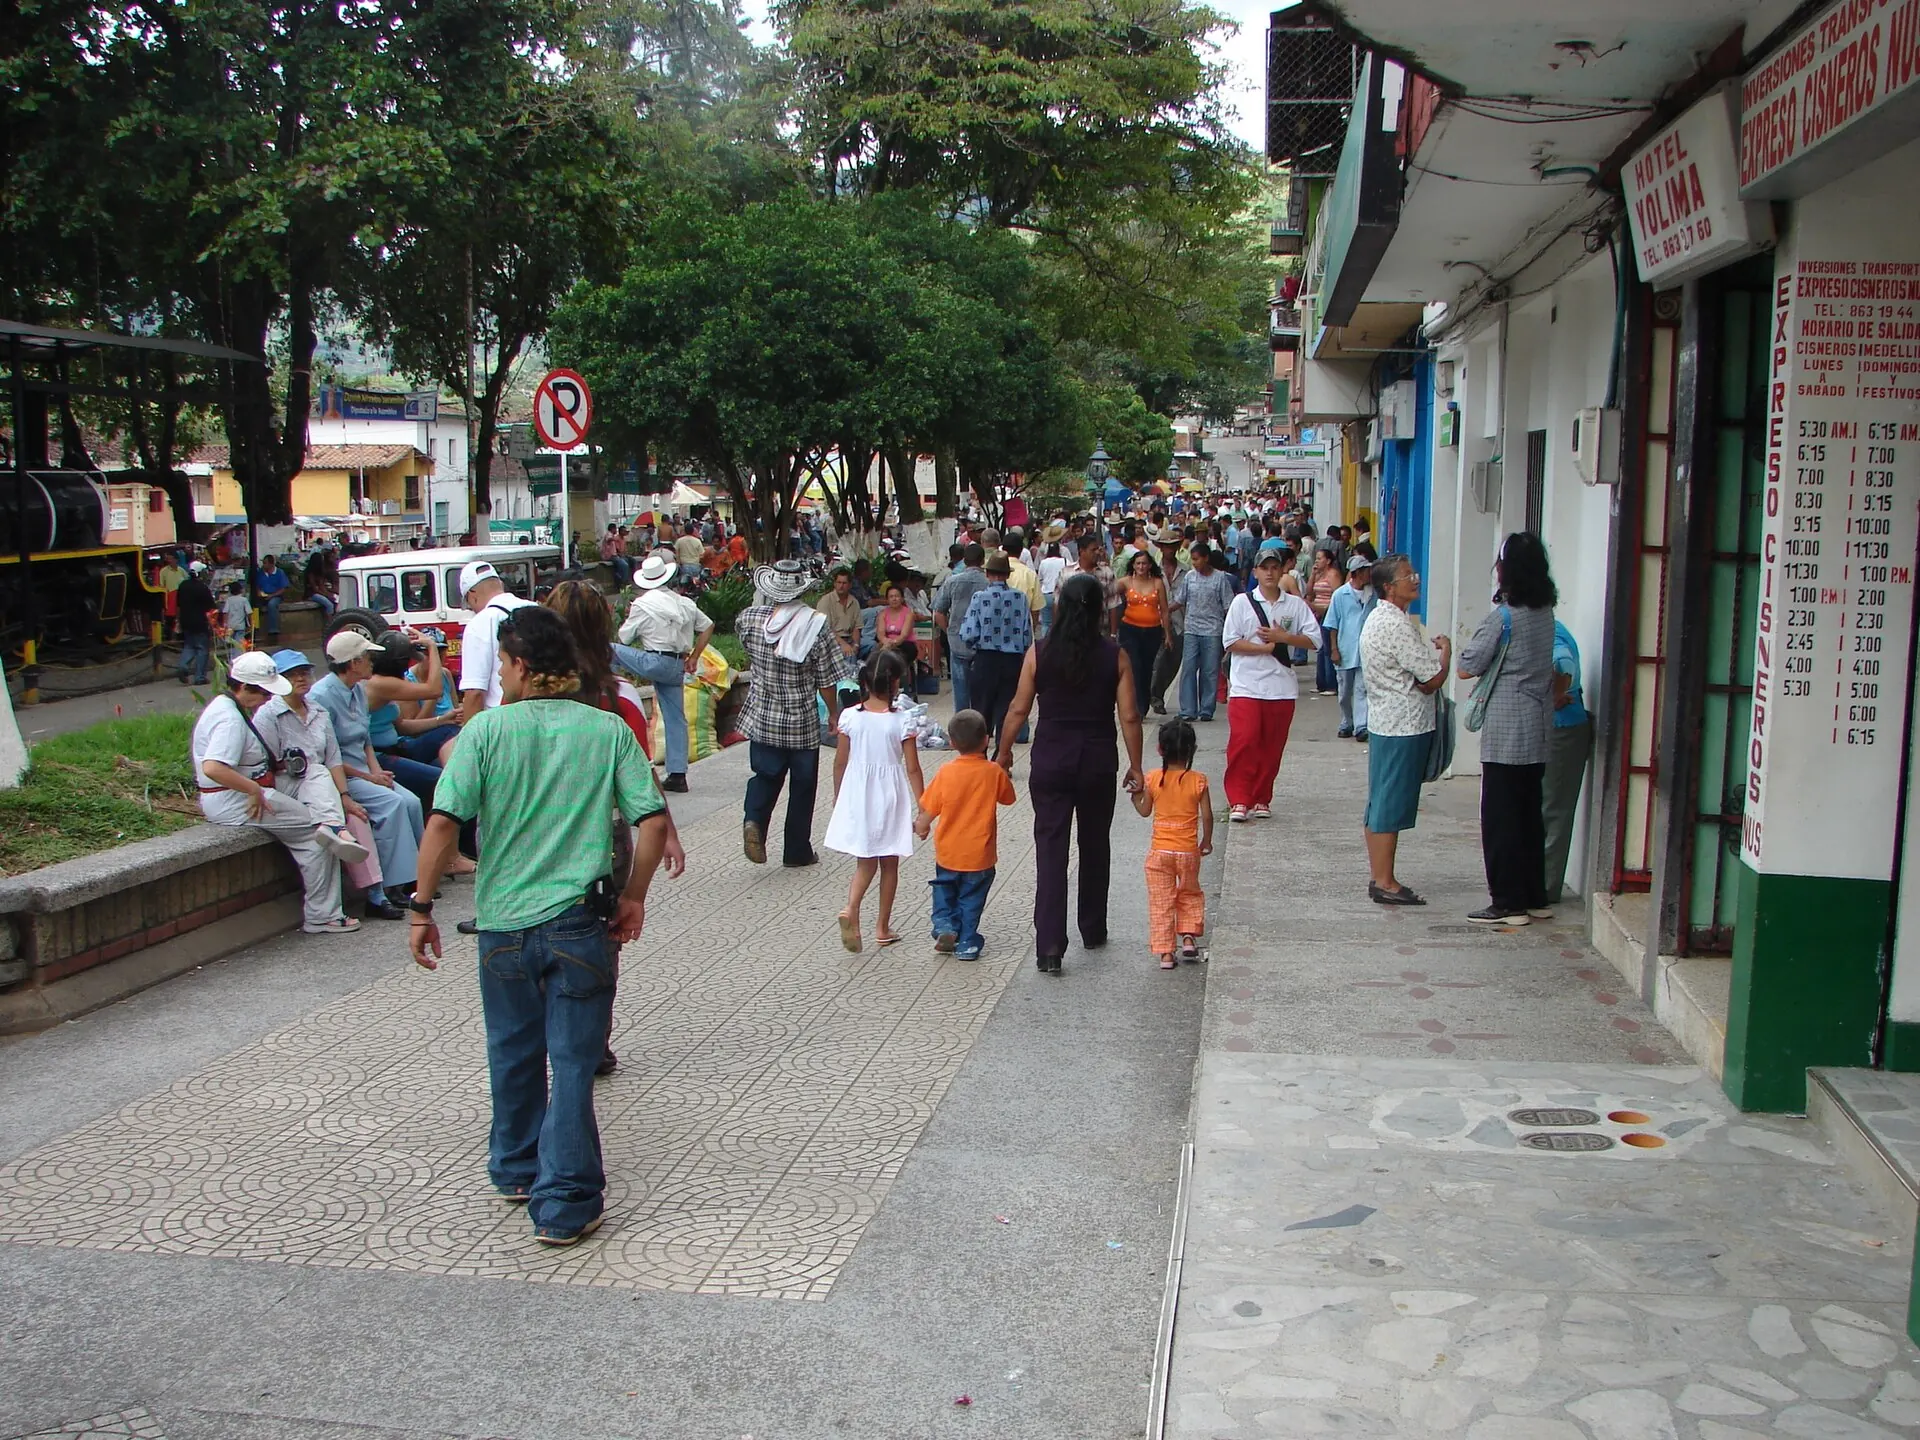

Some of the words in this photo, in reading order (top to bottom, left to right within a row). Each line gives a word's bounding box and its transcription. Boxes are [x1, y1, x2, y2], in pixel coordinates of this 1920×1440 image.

[1742, 31, 1816, 113] INVERSIONES
[1741, 86, 1797, 187] EXPRESO
[1802, 24, 1880, 147] CISNEROS
[1634, 130, 1688, 191] HOTEL
[1636, 162, 1705, 241] YOLIMA
[1644, 243, 1661, 268] TEL:
[1798, 261, 1857, 274] INVERSIONES
[1797, 277, 1849, 298] EXPRESO
[1850, 279, 1906, 299] CISNEROS
[1814, 303, 1844, 317] TEL:
[1850, 305, 1873, 317] 863
[1878, 305, 1893, 318] 19
[1897, 306, 1913, 319] 44
[1802, 320, 1853, 338] HORARIO
[1858, 321, 1874, 339] DE
[1796, 341, 1856, 356] CISNEROS
[1804, 360, 1844, 371] LUNES
[1819, 372, 1826, 383] A
[1890, 374, 1897, 385] Y
[1767, 275, 1792, 517] EXPRESO
[1798, 384, 1845, 397] SABADO
[1863, 386, 1920, 399] FESTIVOS
[552, 382, 581, 437] P
[1799, 420, 1827, 438] 5:30
[1868, 422, 1897, 440] 6:15
[1798, 445, 1825, 462] 6:15
[1868, 447, 1894, 464] 7:00
[1798, 468, 1824, 485] 7:00
[1865, 471, 1893, 488] 8:30
[1795, 492, 1823, 509] 8:30
[1864, 495, 1892, 512] 9:15
[1794, 516, 1821, 533] 9:15
[1855, 518, 1890, 535] 10:00
[1785, 540, 1820, 557] 10:00
[1854, 542, 1889, 559] 11:30
[1784, 563, 1818, 580] 11:30
[1860, 566, 1887, 583] 1:00
[1790, 586, 1817, 603] 1:00
[1857, 589, 1885, 606] 2:00
[1788, 609, 1815, 627] 2:30
[1856, 612, 1883, 630] 2:30
[1786, 633, 1814, 651] 2:45
[1854, 635, 1882, 653] 3:00
[1749, 534, 1776, 803] CISNEROS
[1785, 656, 1812, 673] 4:00
[1852, 659, 1880, 676] 4:00
[1783, 680, 1811, 696] 5:30
[1851, 682, 1878, 699] 5:00
[1849, 705, 1876, 722] 6:00
[1847, 728, 1875, 745] 6:15
[1742, 813, 1762, 857] NUS
